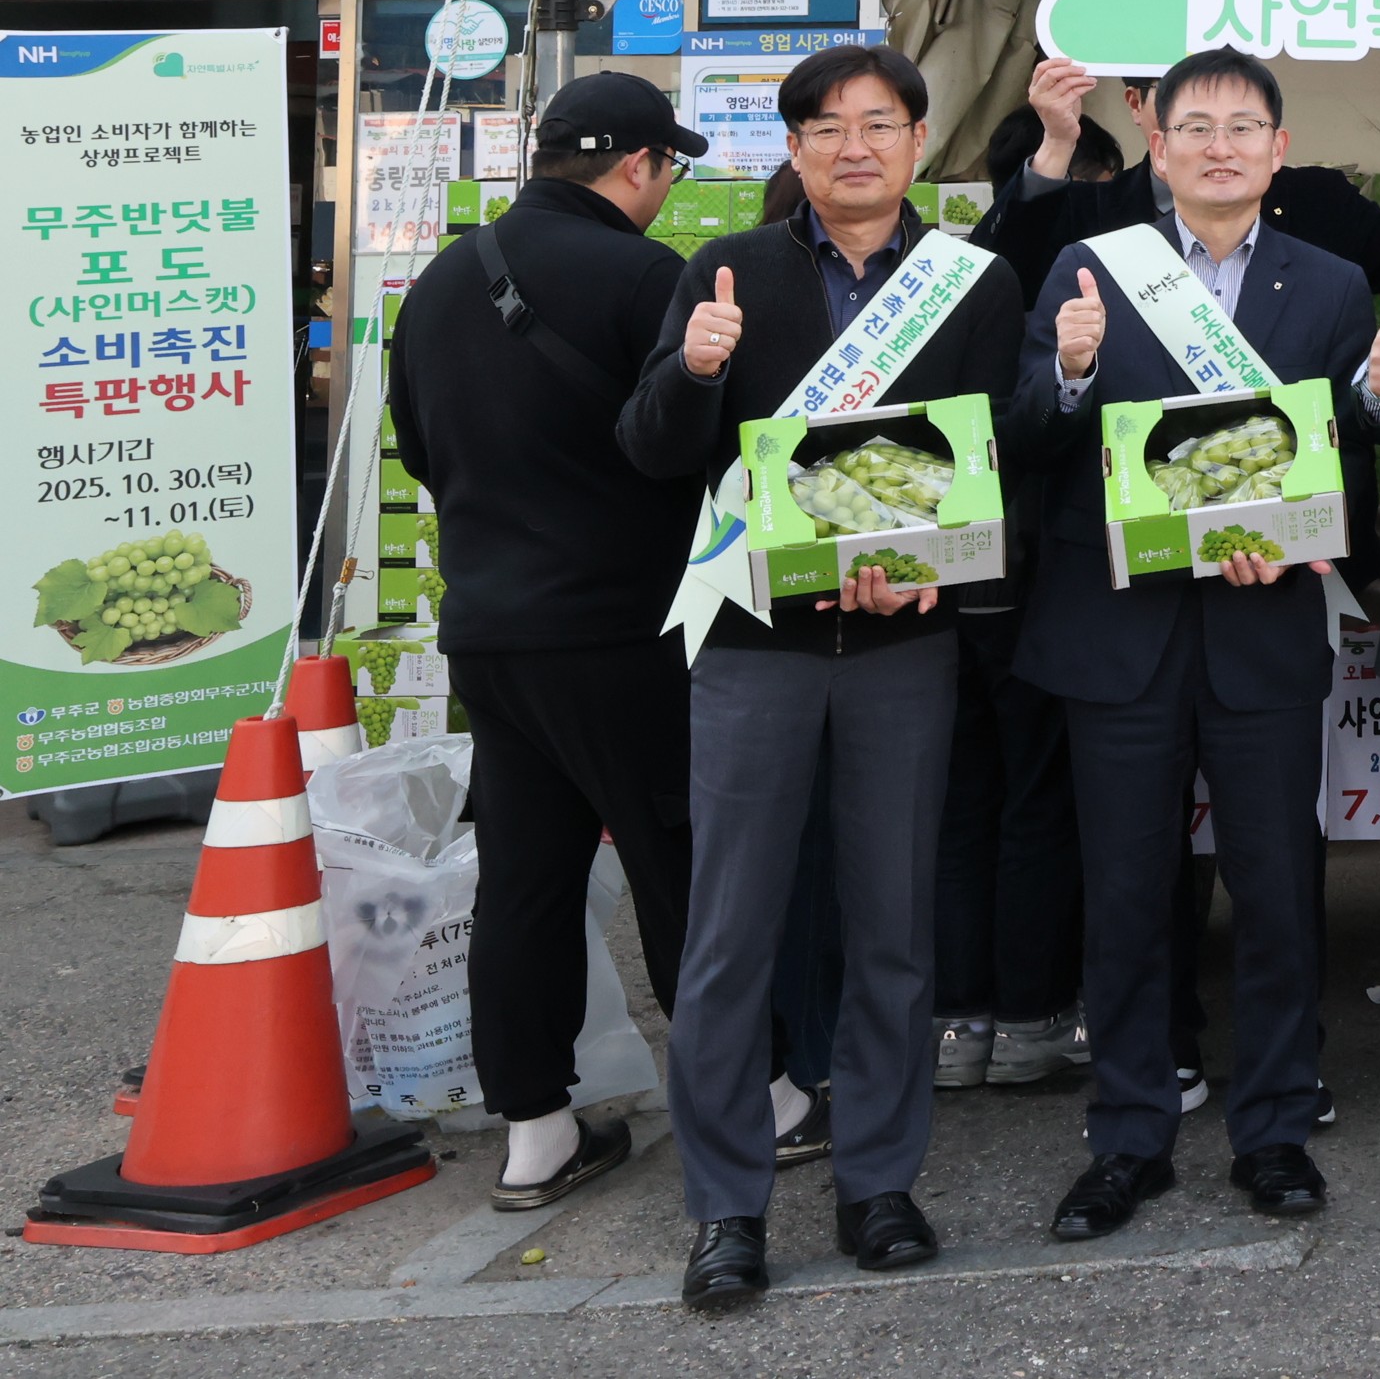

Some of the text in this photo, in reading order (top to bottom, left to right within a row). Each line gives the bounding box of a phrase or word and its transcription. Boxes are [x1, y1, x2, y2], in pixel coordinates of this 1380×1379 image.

[19, 46, 57, 63] NH
[691, 38, 723, 50] NH
[759, 34, 790, 52] 영업
[796, 34, 829, 51] 시간
[726, 97, 773, 110] 영업시간
[20, 119, 257, 145] 농업인 소비자가 함께하는
[81, 146, 201, 167] 상생프로젝트
[22, 198, 260, 240] 무주반딧불
[863, 257, 937, 340] 소비촉진
[39, 324, 248, 368] 소비촉진
[1190, 303, 1269, 388] 무주반딧불
[39, 370, 251, 419] 특판행사
[37, 438, 154, 469] 행사기간
[37, 462, 252, 503] 2025. 10. 30.(목)
[170, 495, 254, 524] 01.(토)
[51, 702, 100, 719] 무주군
[38, 716, 166, 745] 무주농업협동조합
